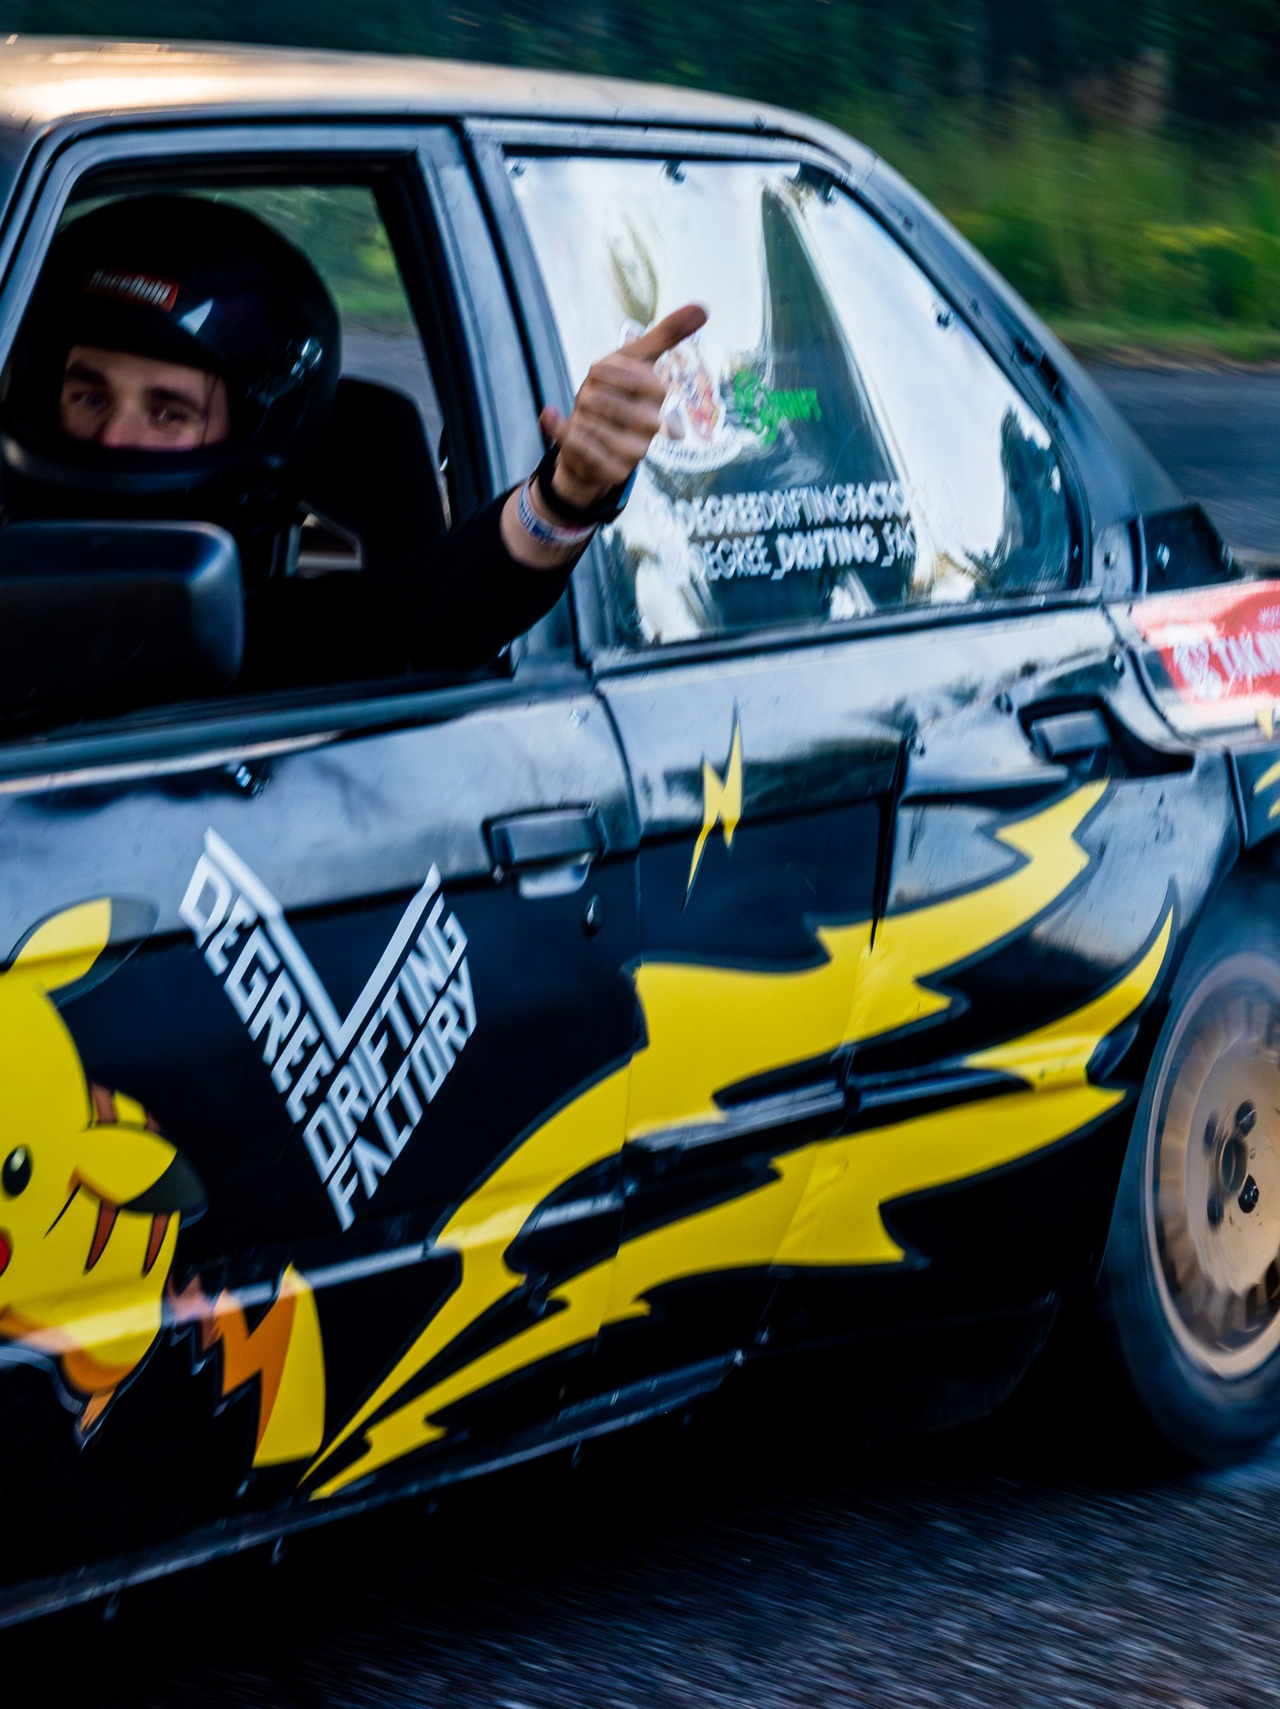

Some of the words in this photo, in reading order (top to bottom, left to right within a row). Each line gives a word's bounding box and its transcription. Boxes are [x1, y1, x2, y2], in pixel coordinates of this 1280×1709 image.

[178, 852, 336, 1124] DEGREE
[303, 892, 468, 1183] DRIFTING
[327, 955, 477, 1232] FACTORY
